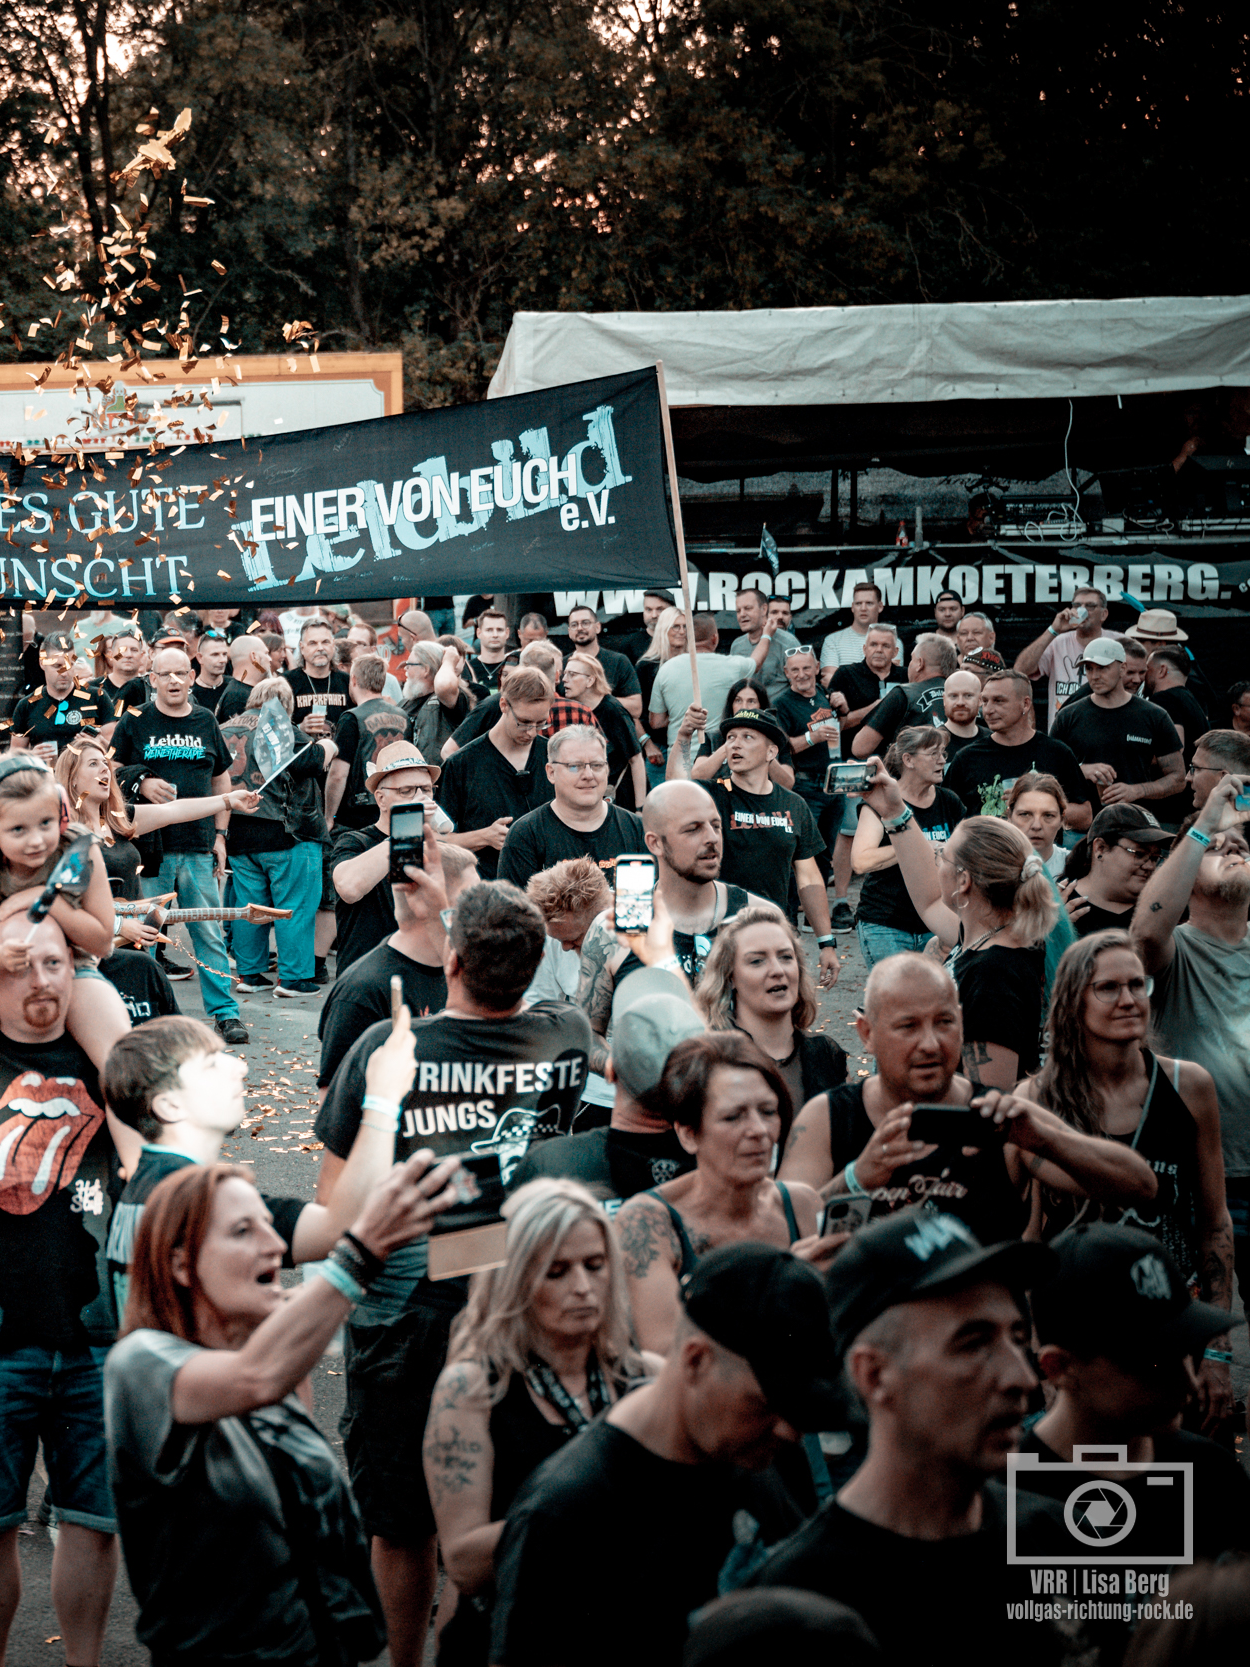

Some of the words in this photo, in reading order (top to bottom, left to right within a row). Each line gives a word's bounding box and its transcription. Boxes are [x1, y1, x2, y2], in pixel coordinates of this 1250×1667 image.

[68, 484, 206, 535] GUTE
[251, 486, 368, 542] EINER
[374, 471, 460, 527] VON
[470, 453, 578, 513] EUCH
[559, 489, 616, 532] e.V.
[296, 693, 347, 708] KAPERFAHRT
[149, 734, 203, 748] Leidbild
[734, 810, 754, 824] EINER
[756, 814, 770, 826] VON
[402, 1099, 498, 1138] JUNGS
